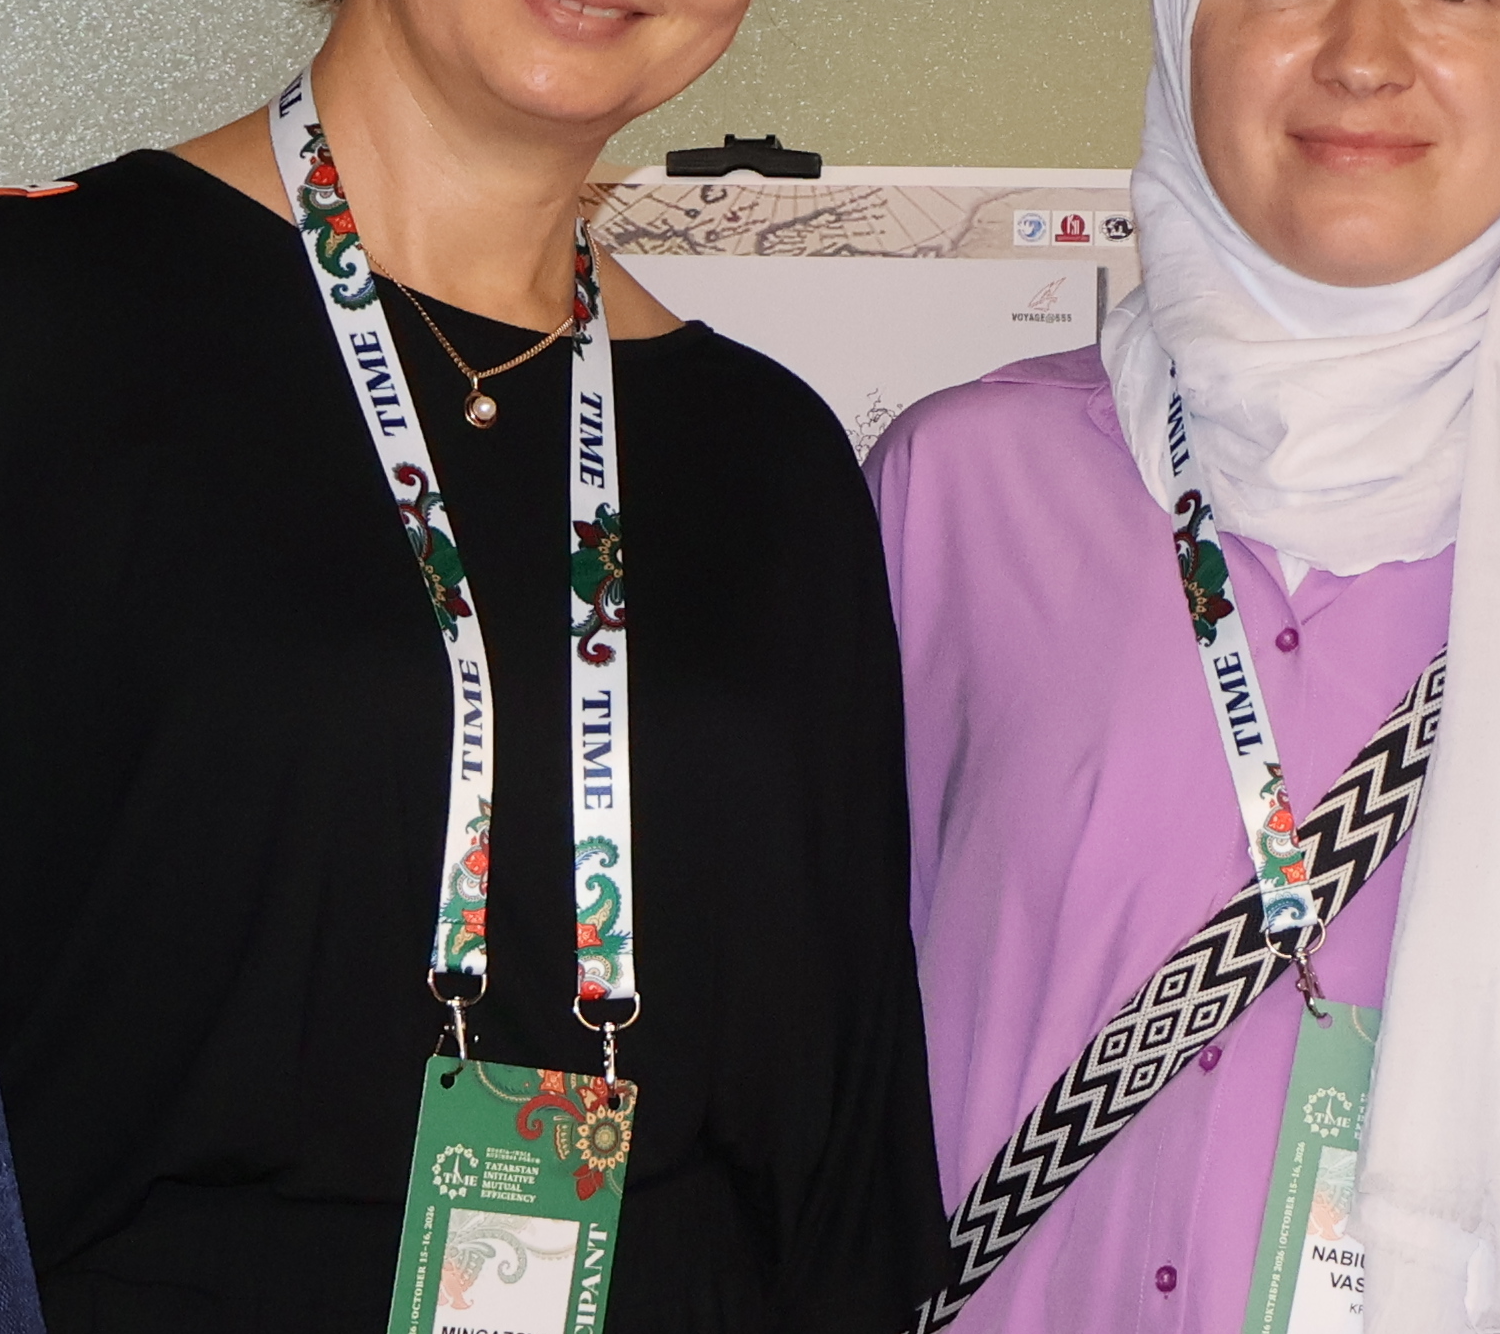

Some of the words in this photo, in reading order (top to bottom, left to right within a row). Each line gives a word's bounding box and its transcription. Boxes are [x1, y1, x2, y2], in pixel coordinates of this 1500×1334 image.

[348, 330, 407, 437] TIME
[578, 392, 604, 490] TIME
[1167, 391, 1190, 477] TIME
[1214, 652, 1262, 757] TIME
[458, 659, 484, 782] TIME
[581, 689, 613, 810] TIME
[1314, 1112, 1351, 1128] TIME
[483, 1171, 535, 1184] INITIATIVE
[485, 1162, 539, 1175] TATARSTAN
[443, 1173, 478, 1187] TIME
[482, 1180, 522, 1192] MUTUAL
[481, 1190, 536, 1203] EFFICIENCY
[1330, 1272, 1365, 1293] VAS
[1350, 1303, 1363, 1314] KF
